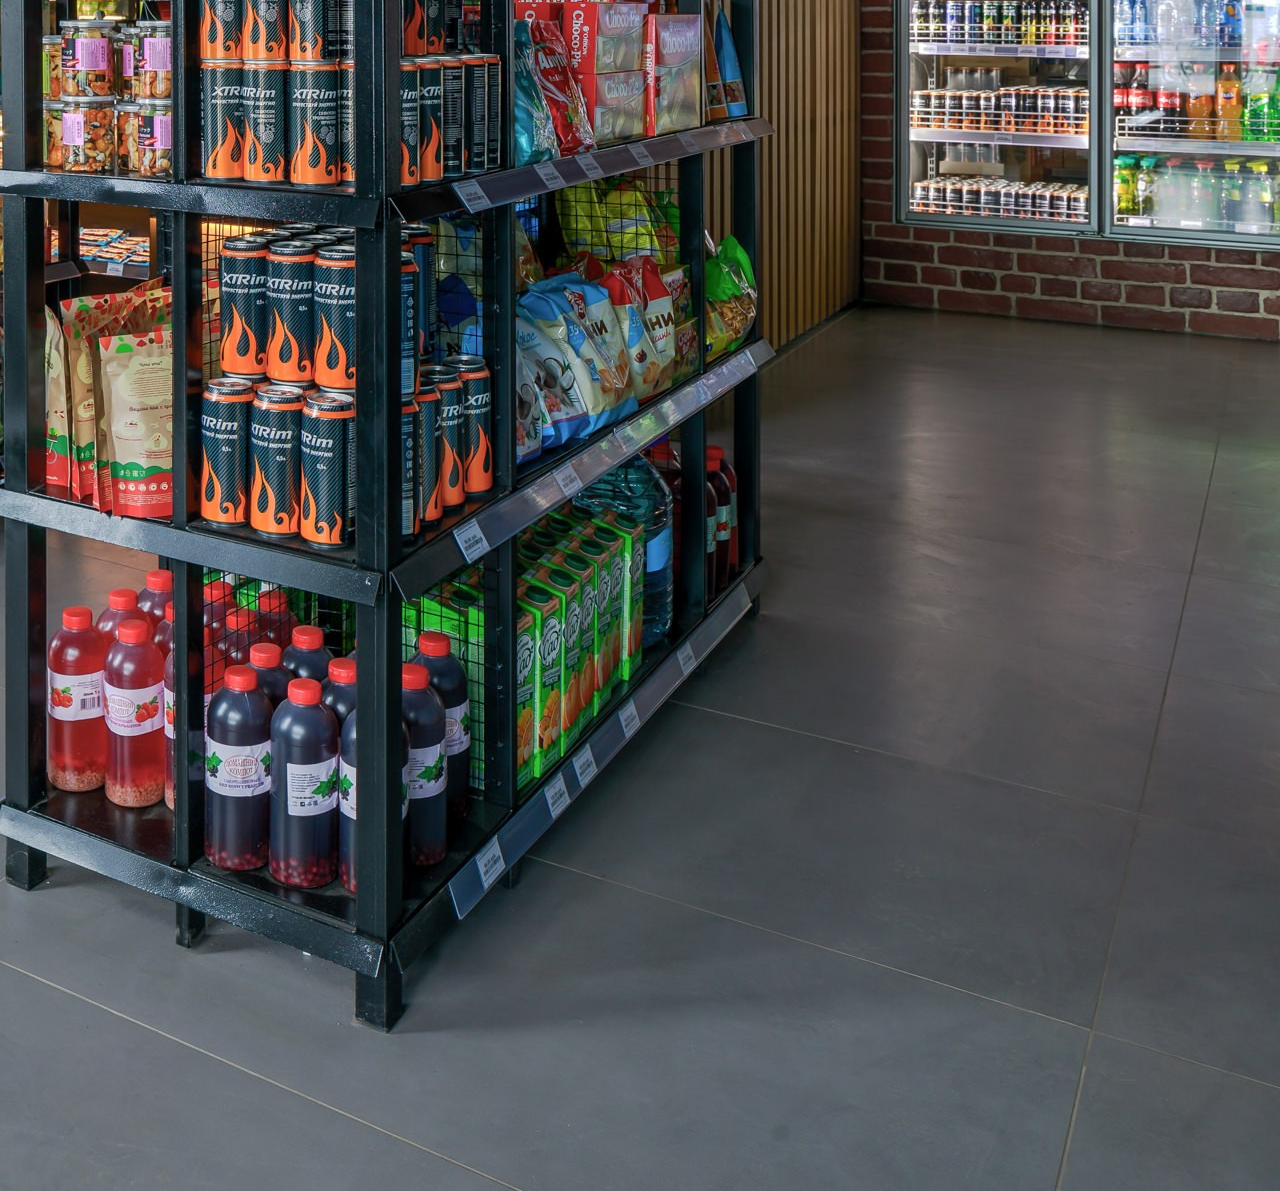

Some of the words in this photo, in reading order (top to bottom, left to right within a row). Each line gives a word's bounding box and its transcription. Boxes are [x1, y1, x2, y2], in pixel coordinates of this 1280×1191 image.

[212, 86, 240, 96] XTR
[293, 89, 336, 99] XTRim
[420, 86, 441, 97] XTR
[267, 277, 312, 290] XTRim
[464, 392, 490, 406] XTR
